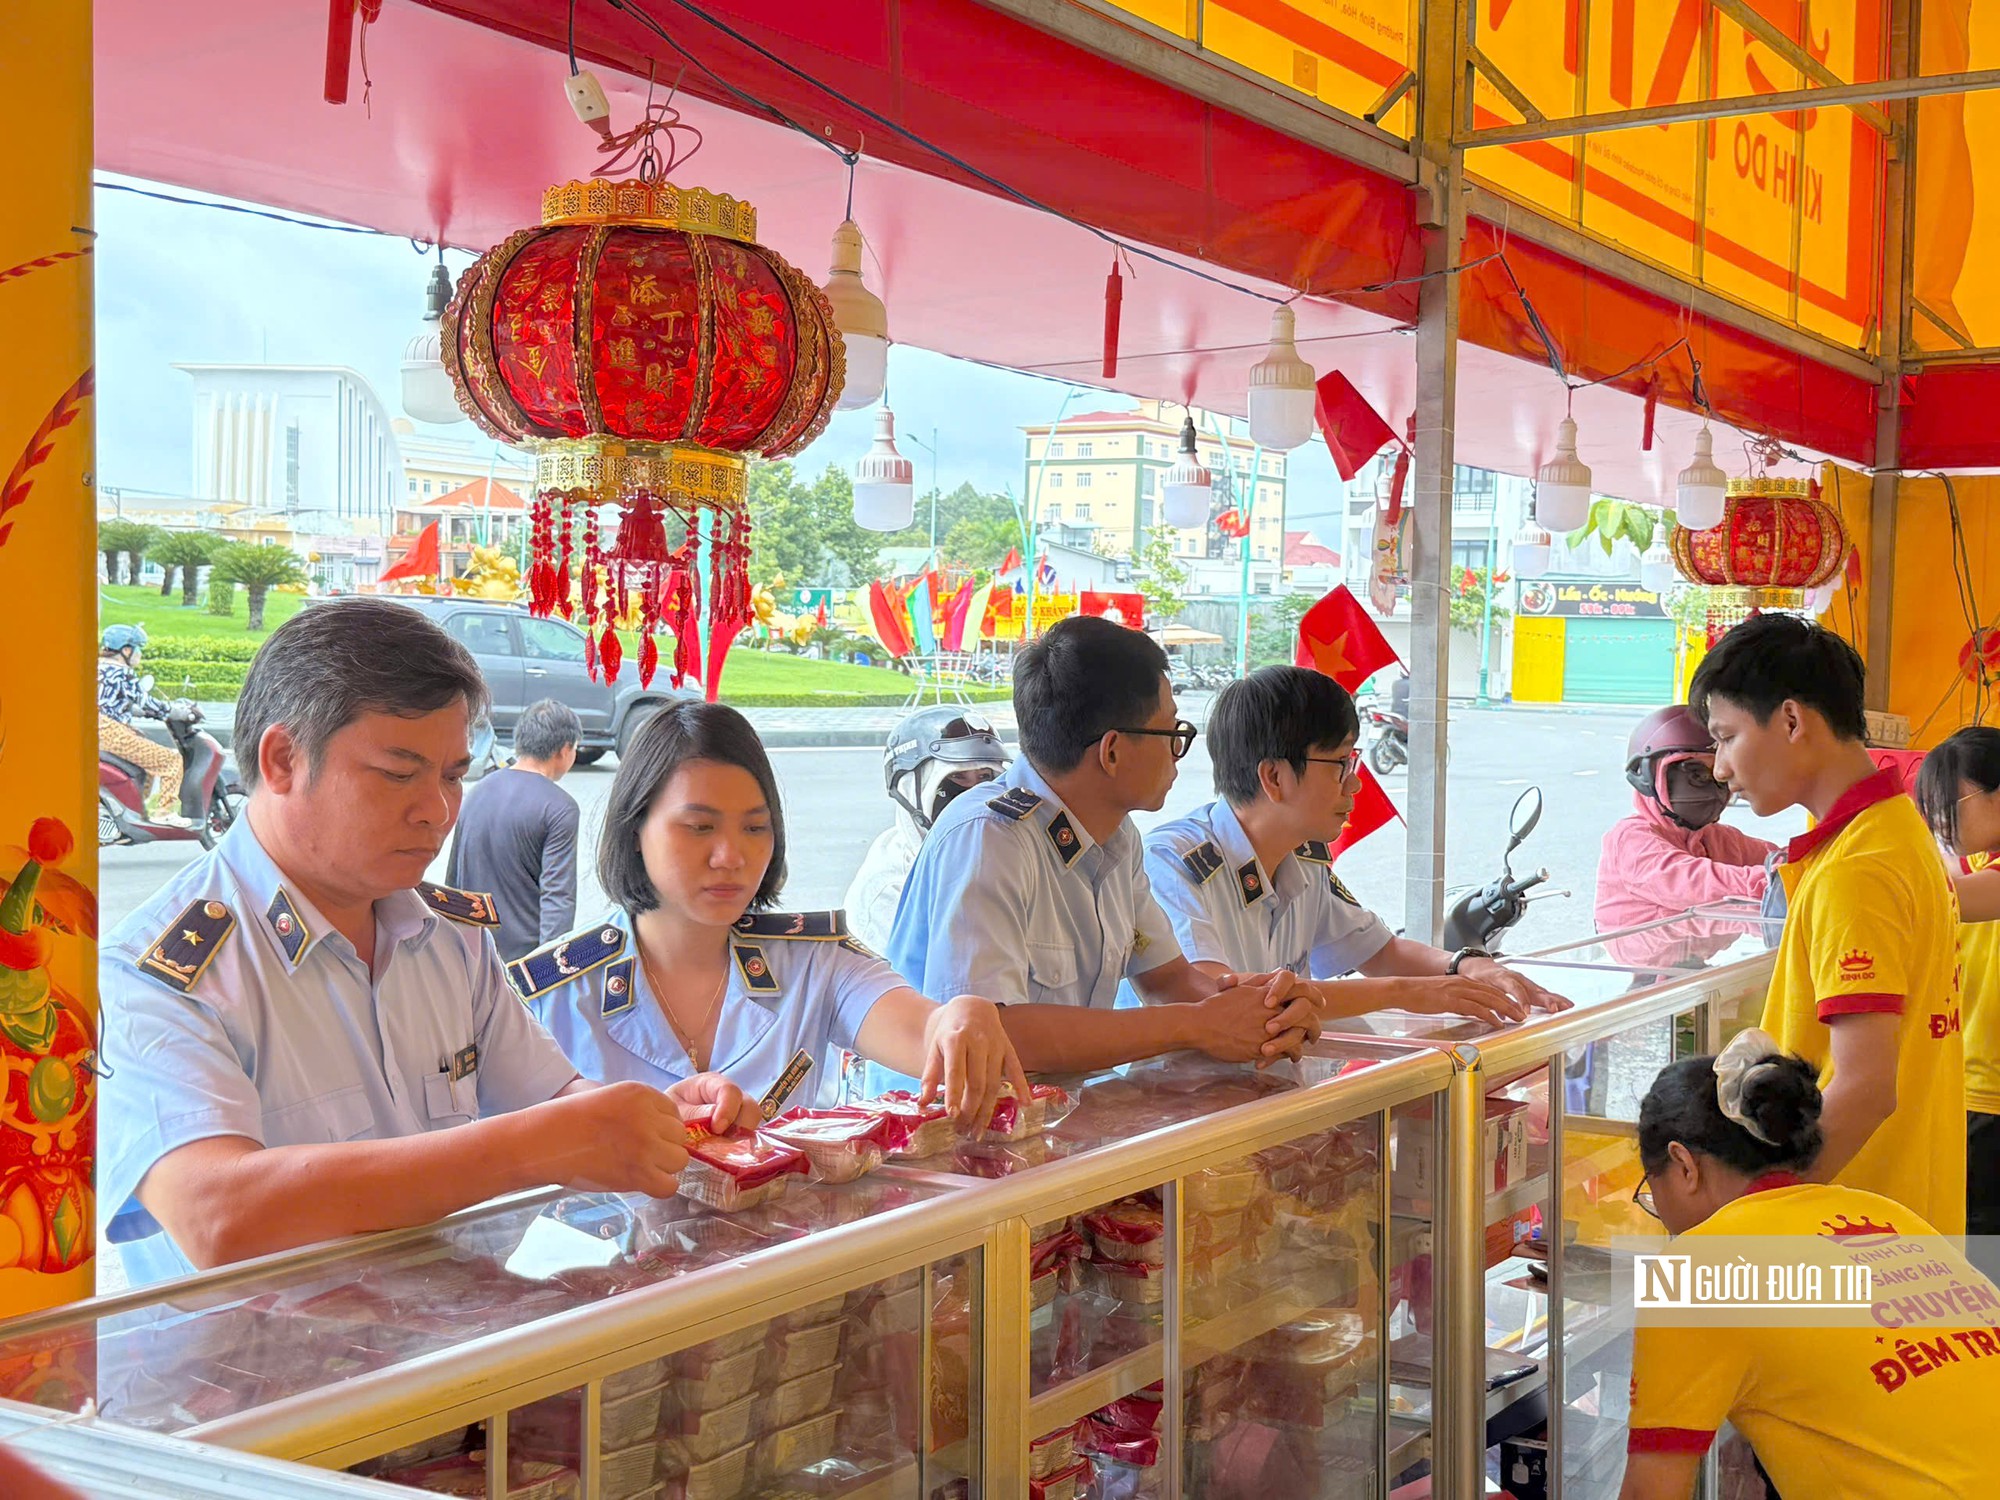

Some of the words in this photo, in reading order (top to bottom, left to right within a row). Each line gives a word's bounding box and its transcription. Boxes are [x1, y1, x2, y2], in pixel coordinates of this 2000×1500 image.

[1849, 1246, 1897, 1265] KINH
[1898, 1243, 1925, 1254] DO
[1871, 1267, 1918, 1287] SÁNG
[1917, 1259, 1953, 1278] MÃI
[1870, 1339, 1960, 1393] ĐÊM
